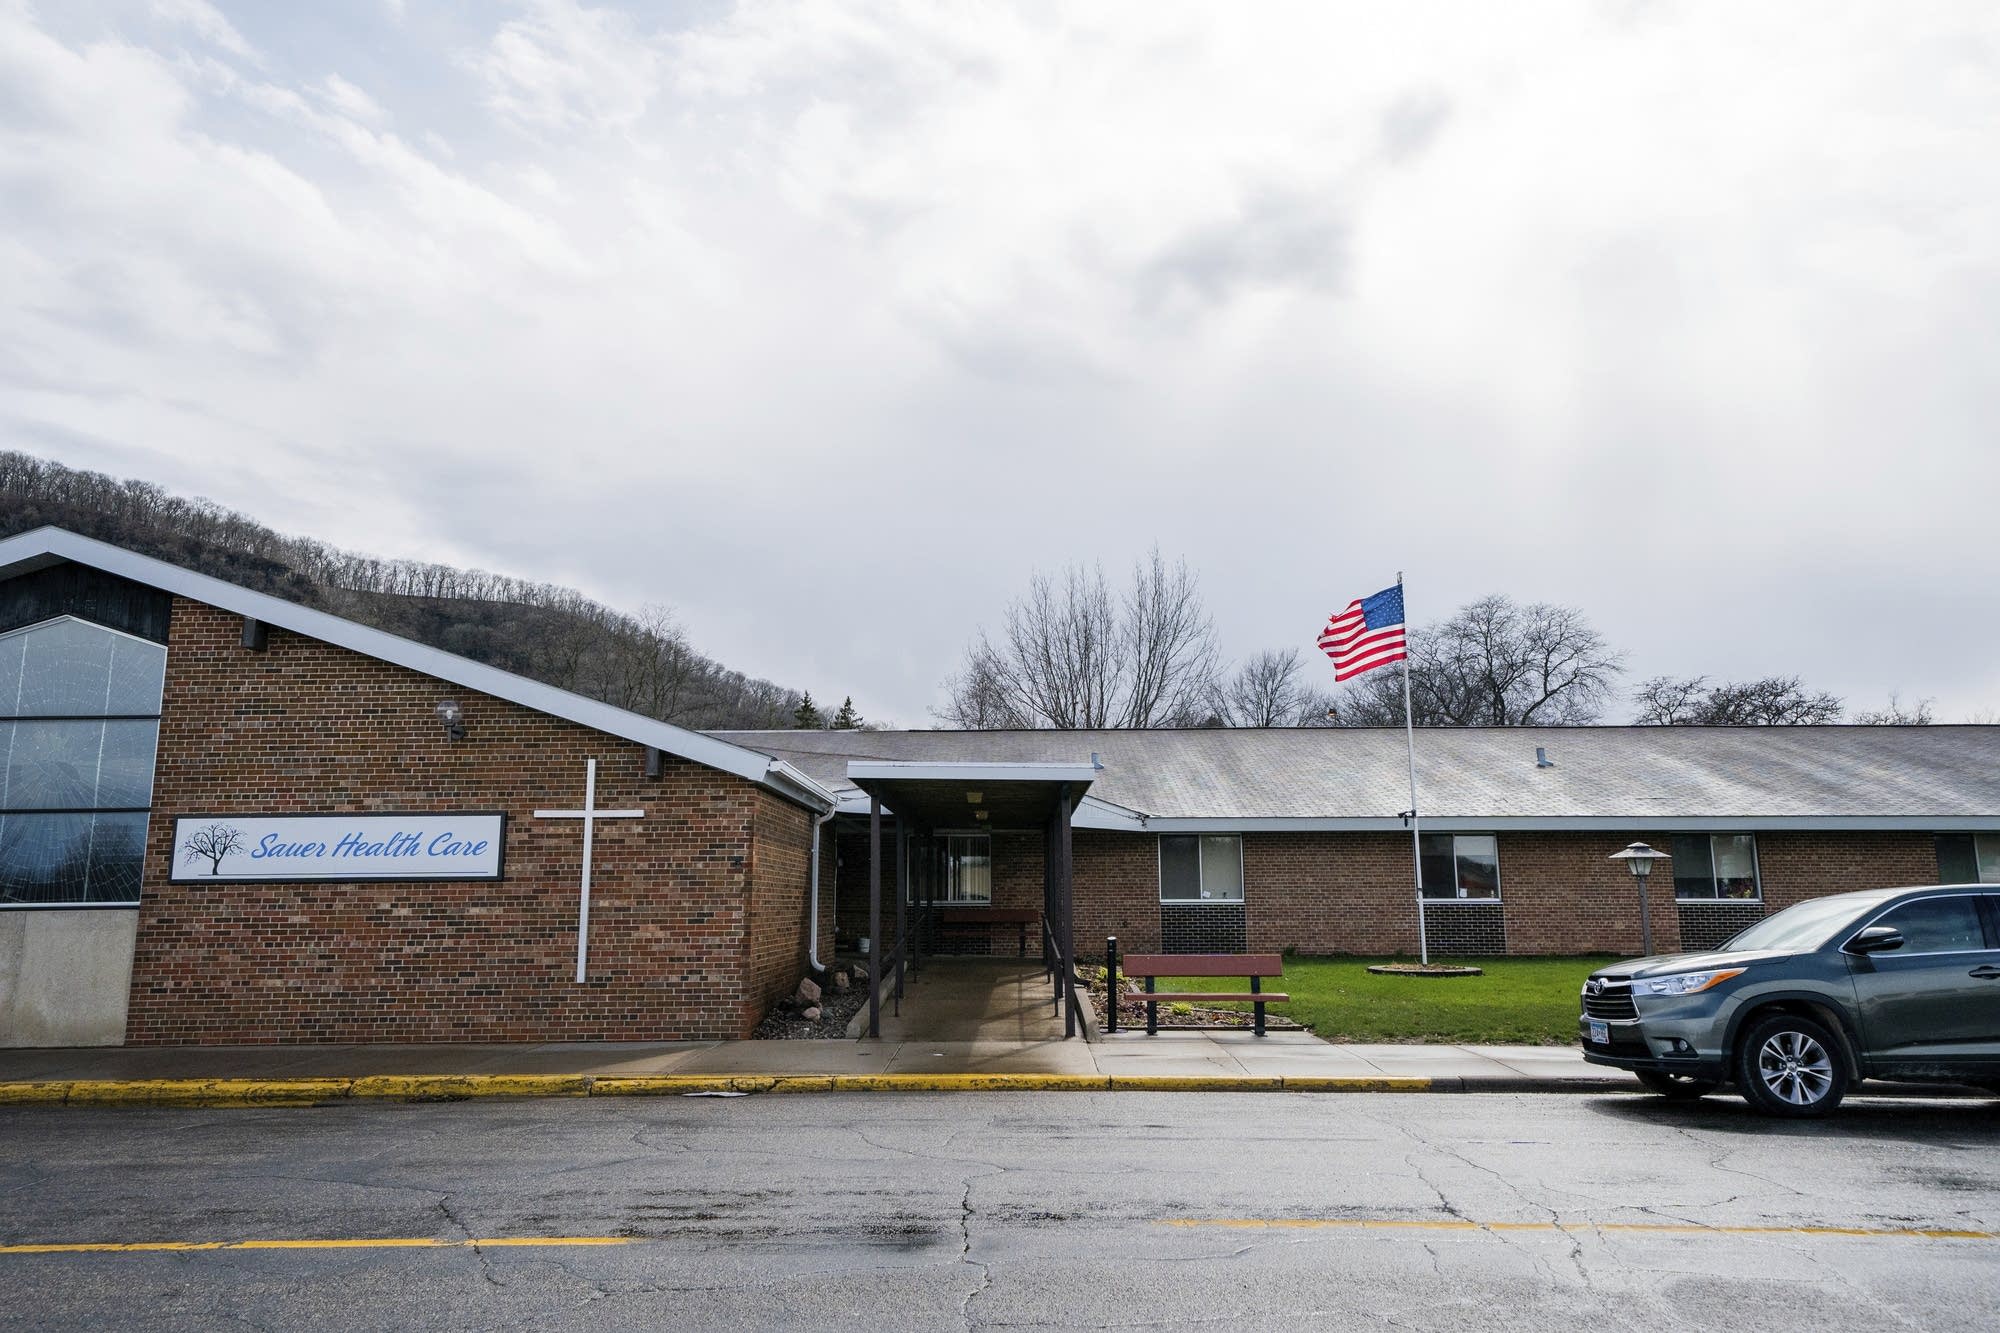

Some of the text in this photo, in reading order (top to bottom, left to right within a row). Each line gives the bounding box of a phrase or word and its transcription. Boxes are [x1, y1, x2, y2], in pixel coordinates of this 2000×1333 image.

[251, 831, 488, 859] Sauer Health Care
